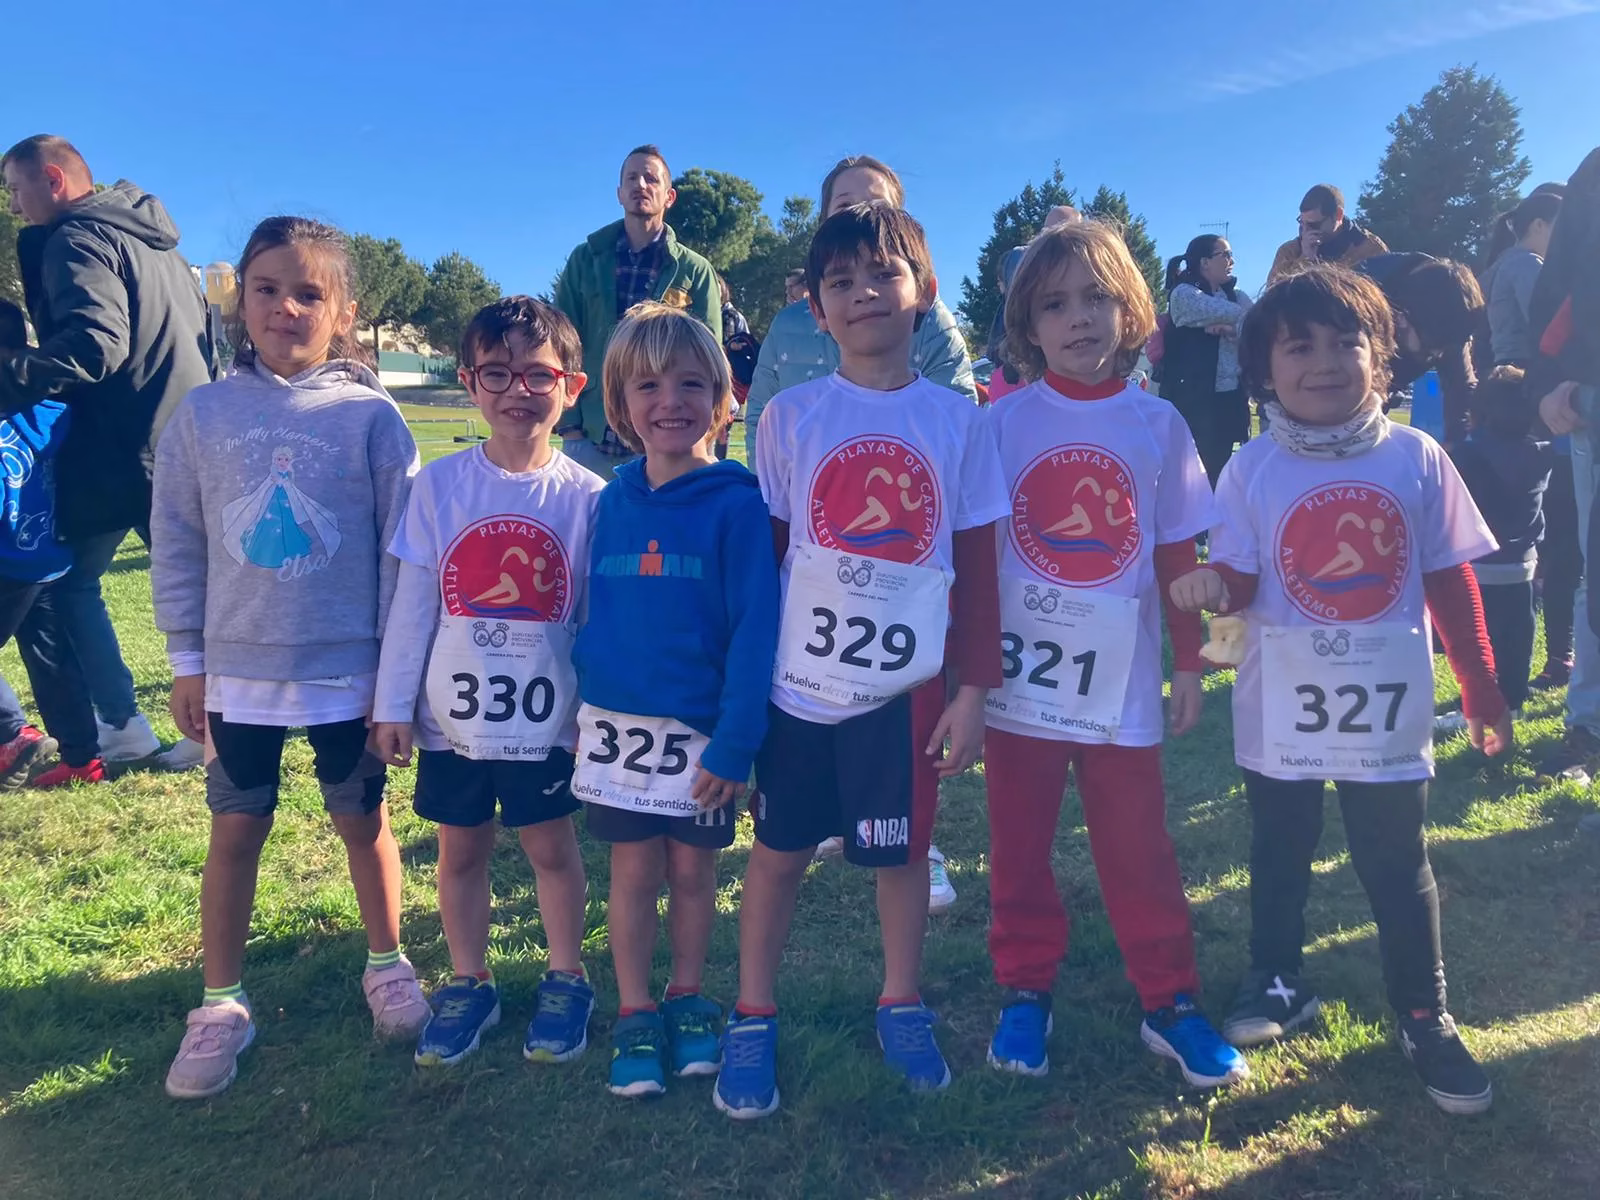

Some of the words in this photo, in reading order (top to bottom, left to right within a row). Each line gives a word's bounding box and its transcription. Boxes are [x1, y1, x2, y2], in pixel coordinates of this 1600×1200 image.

[837, 442, 897, 464] PLAYAS
[904, 454, 923, 475] DE
[1051, 451, 1112, 470] PLAYAS
[1116, 472, 1130, 493] DE
[913, 482, 933, 551] CARTAYA
[1304, 488, 1368, 512] PLAYAS
[1376, 497, 1397, 518] DE
[479, 522, 538, 539] PLAYAS
[812, 498, 842, 551] ATLETI
[1015, 492, 1060, 575] ATLETISMO
[542, 539, 559, 559] DE
[445, 561, 463, 617] ATLETI
[544, 566, 566, 624] CARTAY
[1281, 545, 1339, 619] ATLETISMO
[804, 606, 917, 672] 329
[448, 672, 556, 724] 330
[785, 671, 821, 691] Huelva
[851, 691, 871, 702] tus
[1040, 711, 1058, 723] tus
[1059, 716, 1107, 733] sentidos
[1294, 682, 1408, 733] 327
[503, 744, 520, 755] tus
[586, 719, 692, 776] 325
[1280, 754, 1324, 768] Huelva
[634, 796, 651, 807] tus
[652, 798, 699, 812] sentidos
[873, 817, 909, 847] NBA
